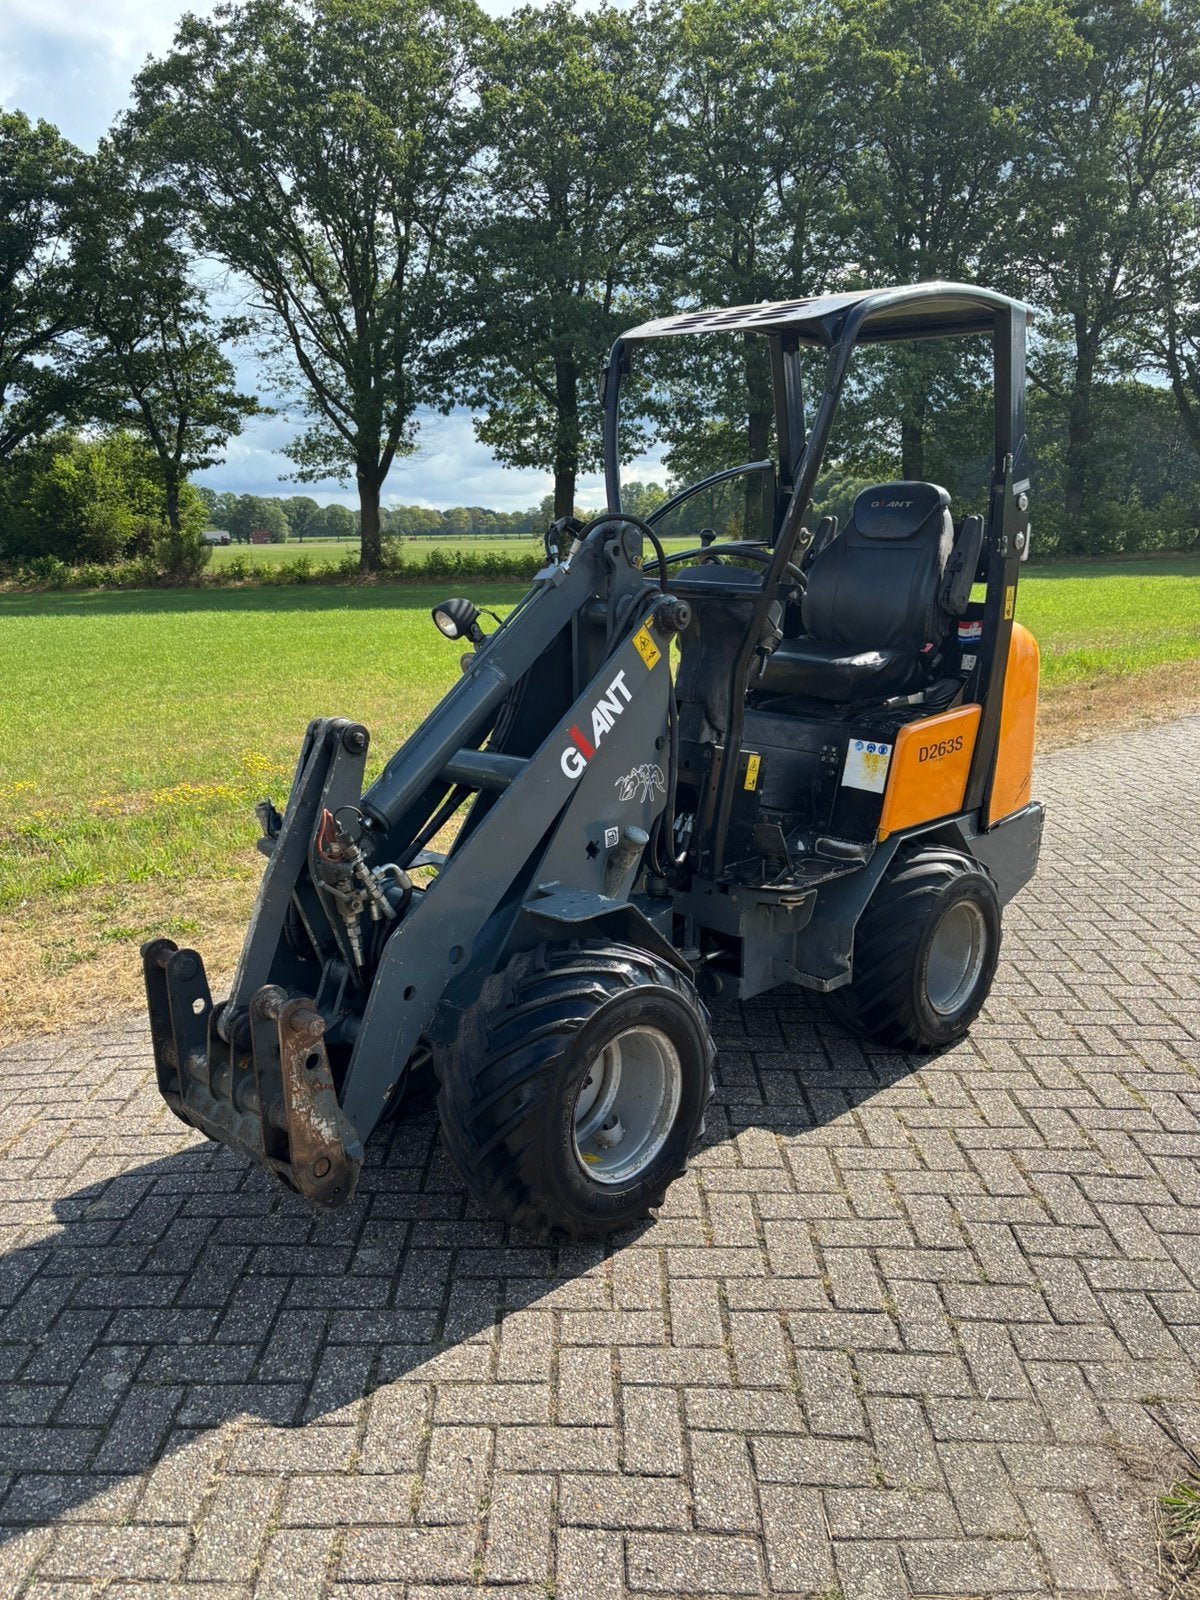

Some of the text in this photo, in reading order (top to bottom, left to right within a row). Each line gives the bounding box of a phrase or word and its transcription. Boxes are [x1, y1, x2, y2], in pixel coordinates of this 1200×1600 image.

[871, 499, 913, 508] GIANT
[560, 669, 633, 779] GIANT
[918, 735, 964, 763] D263S
